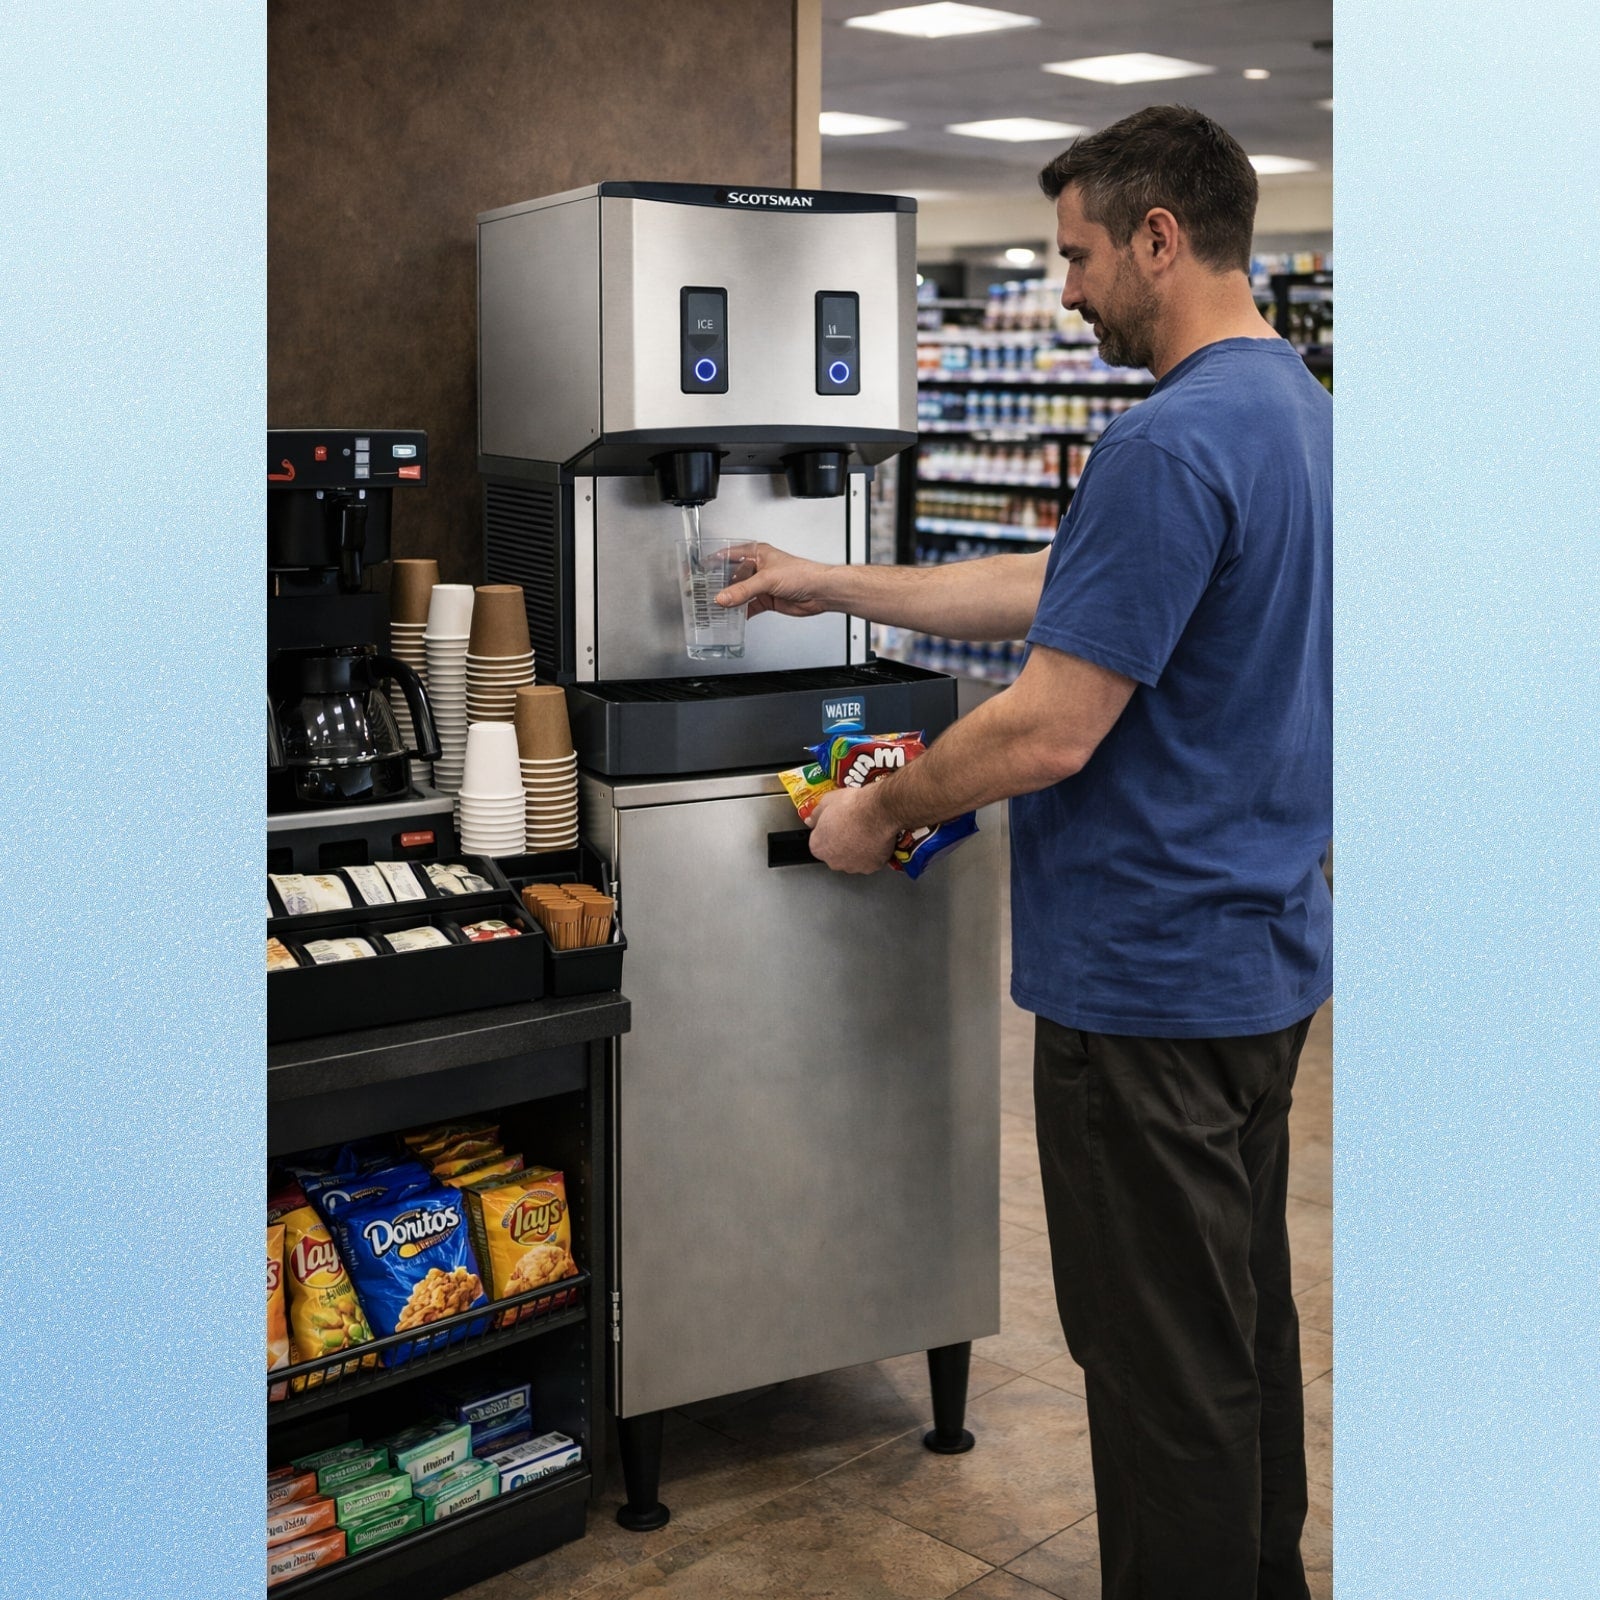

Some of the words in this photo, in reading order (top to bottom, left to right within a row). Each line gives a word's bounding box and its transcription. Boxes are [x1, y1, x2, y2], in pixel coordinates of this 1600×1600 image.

[727, 192, 814, 207] SCOTSMAN
[697, 319, 714, 330] ICE
[825, 702, 861, 718] WATER
[363, 1206, 460, 1255] Doritos
